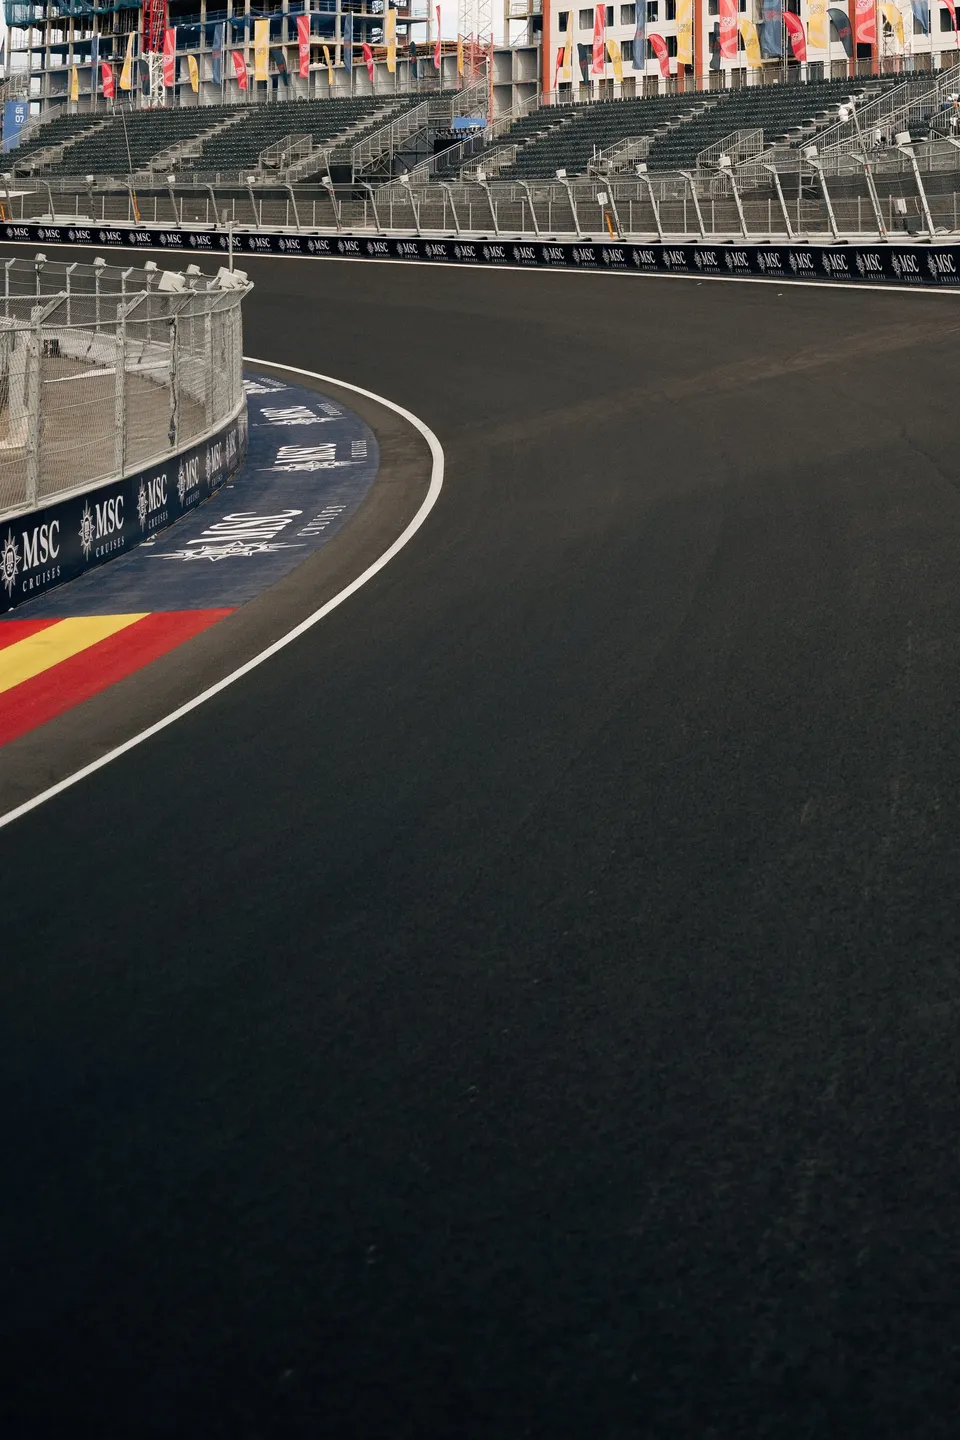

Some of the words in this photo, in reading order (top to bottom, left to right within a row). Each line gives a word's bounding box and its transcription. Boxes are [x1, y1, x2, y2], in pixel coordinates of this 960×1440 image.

[15, 115, 24, 123] 07
[255, 238, 270, 248] MSC
[284, 238, 300, 248] MSC
[314, 239, 330, 250] MSC
[344, 240, 360, 251] MSC
[373, 242, 389, 252] MSC
[402, 243, 418, 254] MSC
[431, 244, 447, 255] MSC
[460, 246, 476, 256] MSC
[490, 246, 506, 258] MSC
[520, 247, 536, 258] MSC
[548, 248, 565, 260] MSC
[579, 249, 596, 261] MSC
[608, 249, 625, 262] MSC
[639, 250, 656, 264] MSC
[670, 250, 686, 264] MSC
[701, 251, 718, 265] MSC
[732, 252, 749, 266] MSC
[764, 252, 782, 268] MSC
[796, 252, 814, 268] MSC
[829, 254, 848, 270] MSC
[862, 253, 883, 272] MSC
[898, 253, 920, 272] MSC
[936, 254, 956, 272] MSC
[211, 442, 222, 472] MSC
[275, 443, 336, 464] MSC
[185, 456, 200, 491] MSC
[148, 474, 168, 512] MSC
[95, 495, 124, 539] MSC
[148, 510, 168, 530] CRUISES
[186, 509, 303, 544] MSC
[22, 520, 60, 572] MSC
[95, 536, 125, 558] CRUISES
[22, 566, 61, 592] CRUISES
